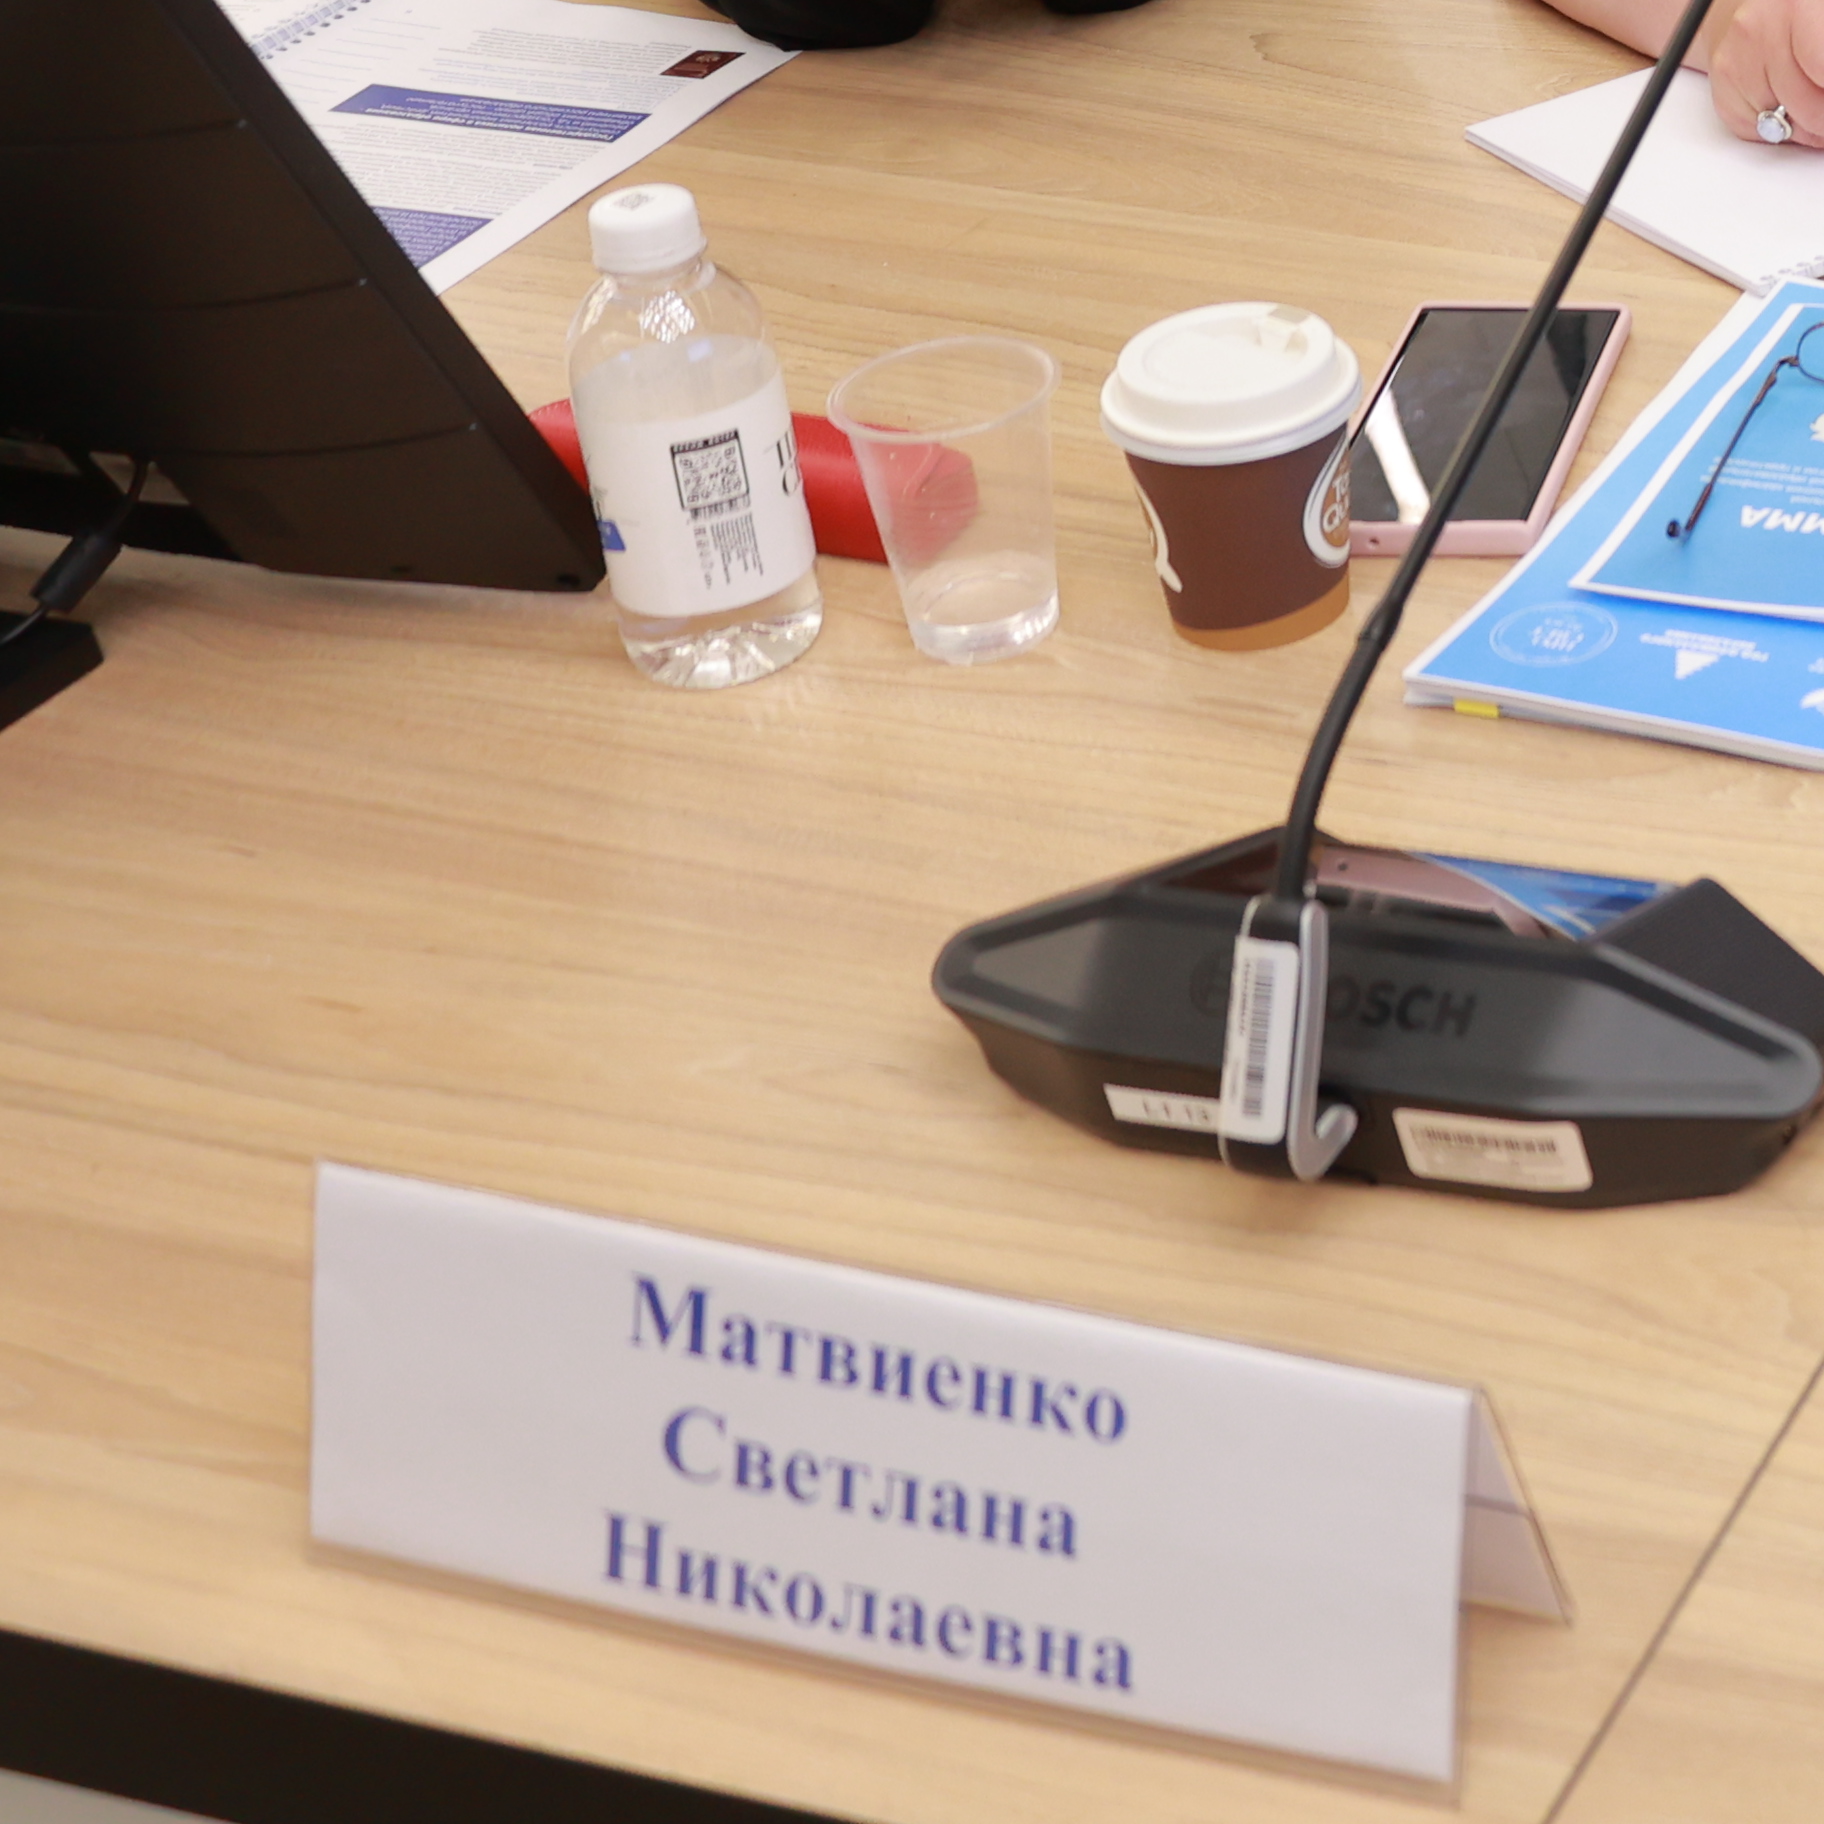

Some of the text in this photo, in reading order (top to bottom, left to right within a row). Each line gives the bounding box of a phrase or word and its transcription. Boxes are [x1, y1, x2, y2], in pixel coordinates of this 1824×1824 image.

[1324, 973, 1478, 1038] OSCH
[630, 1274, 1130, 1444] Матвиенко
[661, 1405, 1079, 1560] Светлана
[602, 1511, 1135, 1692] Николаевна
